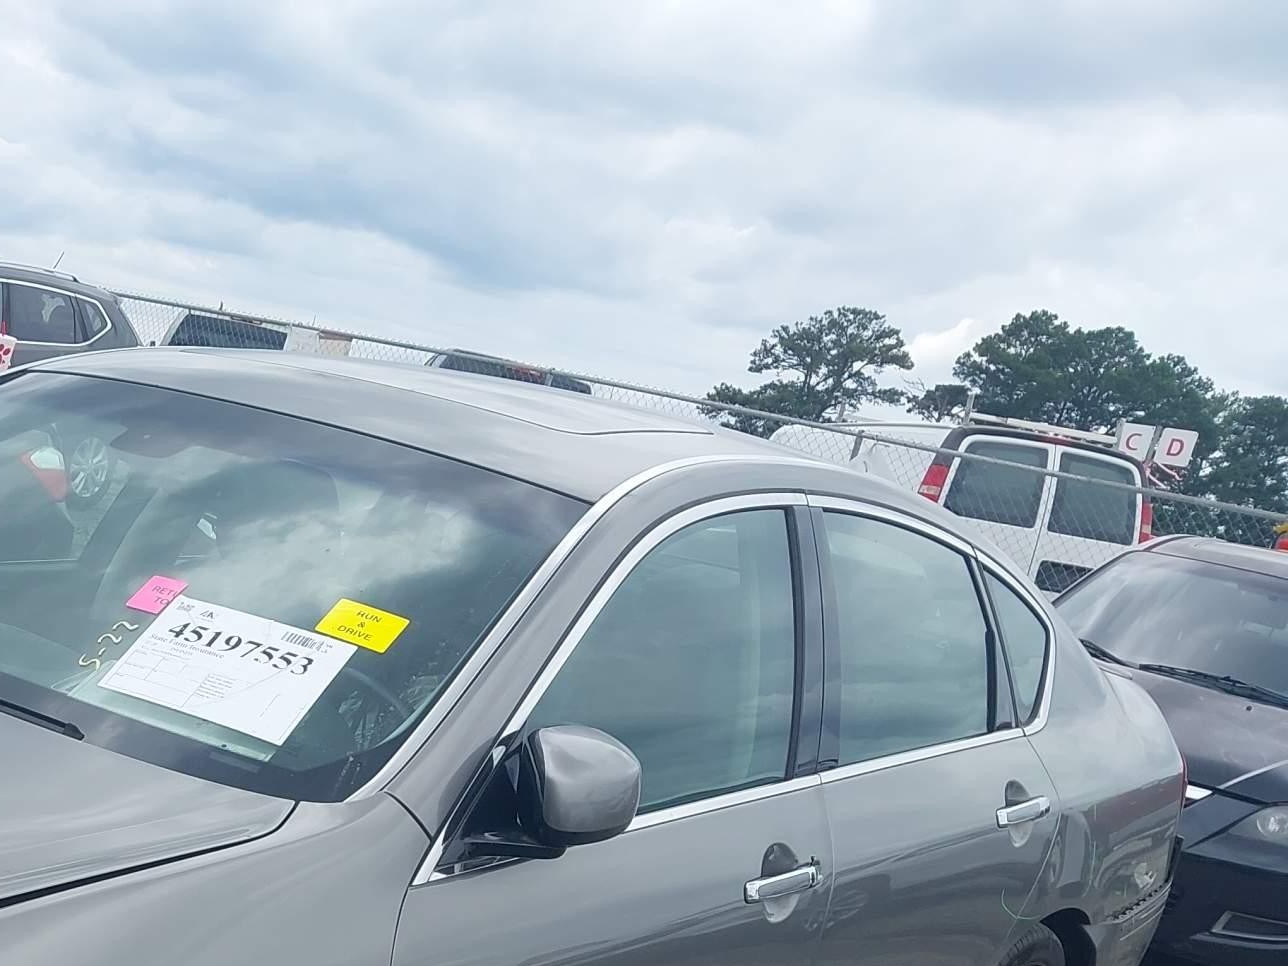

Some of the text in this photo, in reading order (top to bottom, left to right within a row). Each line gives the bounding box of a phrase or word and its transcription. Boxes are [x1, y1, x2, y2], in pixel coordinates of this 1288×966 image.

[1125, 433, 1143, 451] C
[1166, 438, 1185, 457] D
[356, 610, 383, 623] RUN
[337, 625, 374, 641] DRIVE
[357, 621, 366, 629] &
[167, 622, 314, 675] 45197553
[169, 638, 188, 649] Farm
